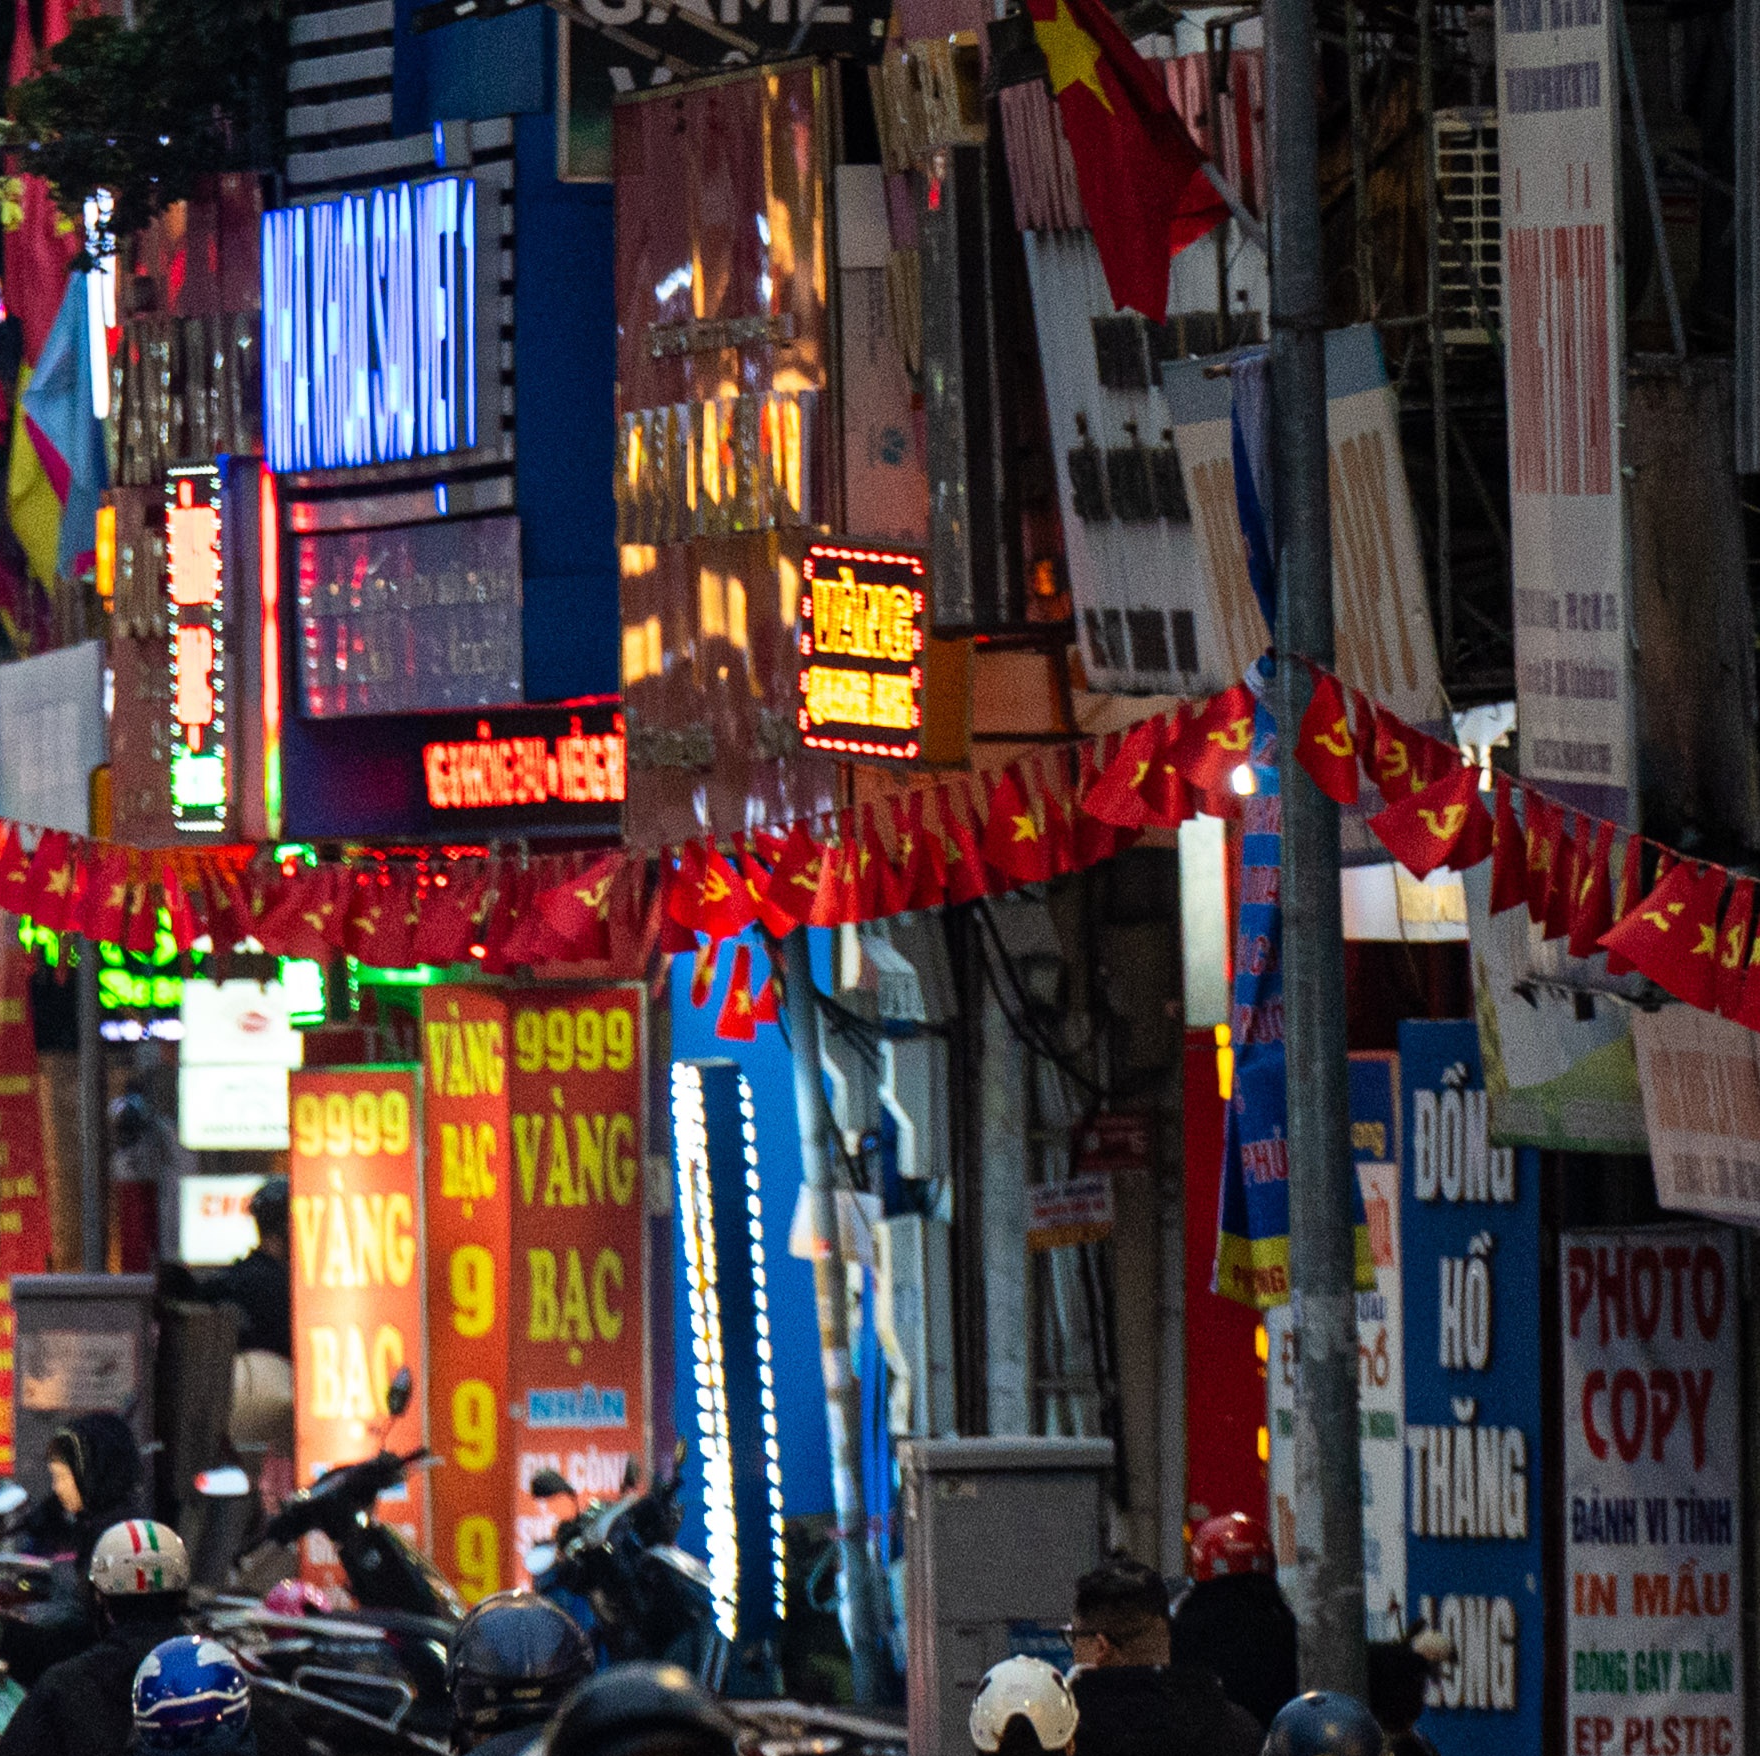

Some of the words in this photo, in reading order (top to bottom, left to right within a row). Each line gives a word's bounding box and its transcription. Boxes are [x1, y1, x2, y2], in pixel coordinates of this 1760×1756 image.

[426, 1000, 504, 1097] VÀNG
[515, 1008, 633, 1073] 9999
[294, 1090, 410, 1158] 9999
[440, 1122, 497, 1220] BẠC
[511, 1086, 637, 1207] VÀNG
[292, 1168, 416, 1288] VÀNG
[450, 1245, 495, 1338] 9
[527, 1247, 624, 1366] BẠC
[1439, 1230, 1492, 1369] HỒ
[1568, 1247, 1725, 1347] PHOTO
[452, 1379, 497, 1472] 9
[1407, 1397, 1527, 1538] THĂNG
[1582, 1369, 1714, 1472] COPY
[455, 1515, 500, 1603] 9
[1646, 1499, 1668, 1544] VI
[1574, 1572, 1617, 1616] IN
